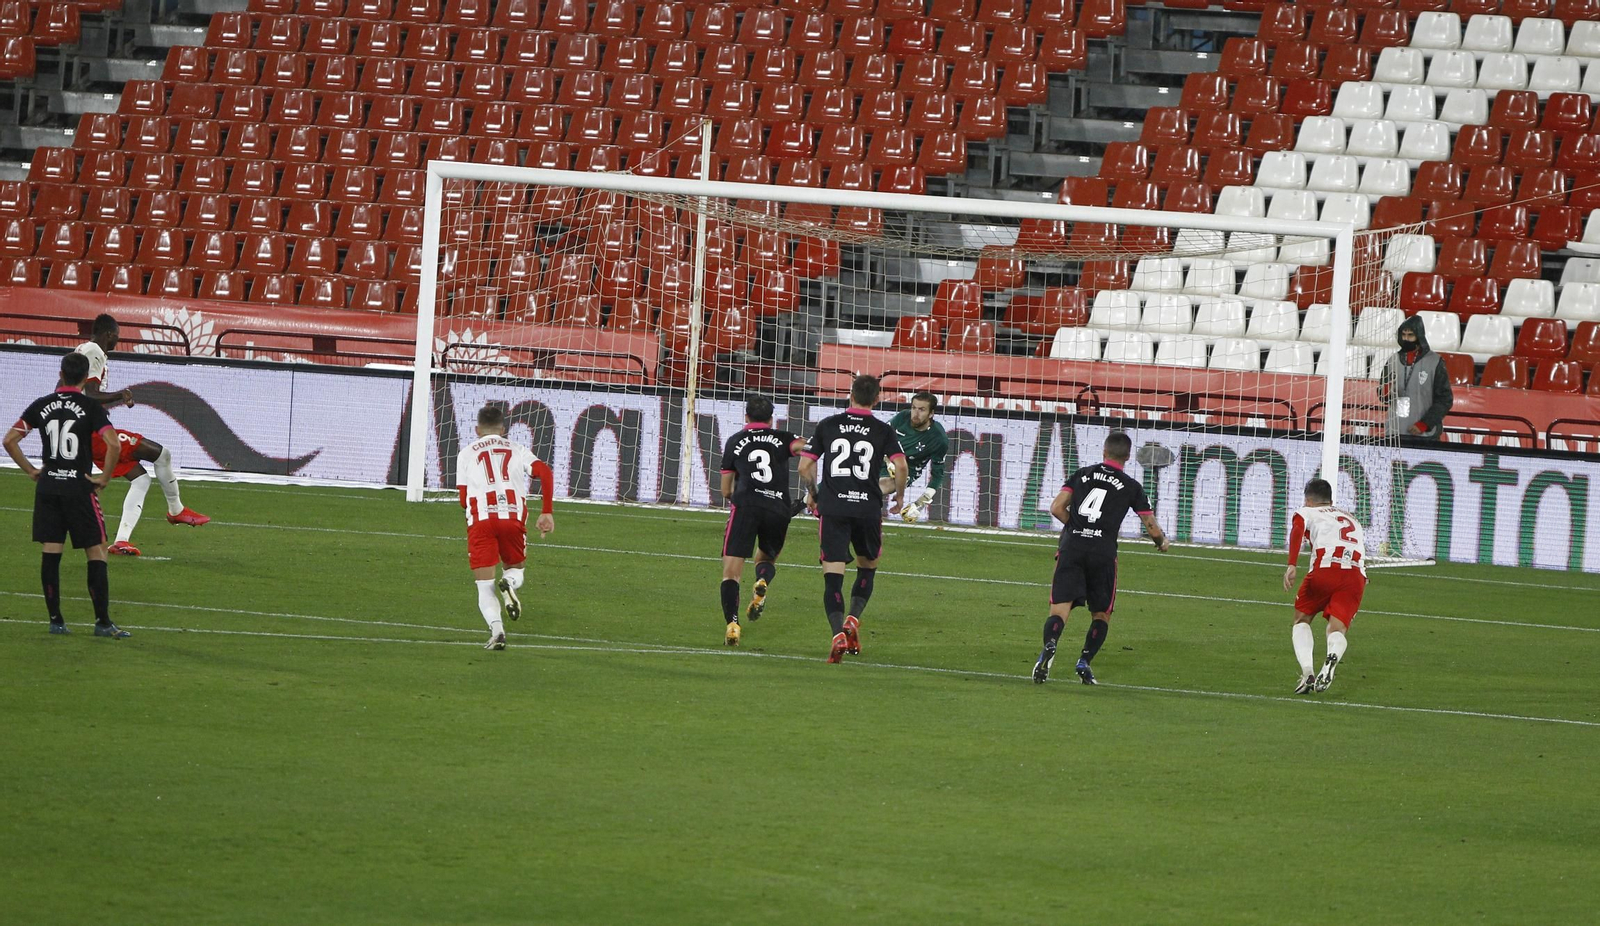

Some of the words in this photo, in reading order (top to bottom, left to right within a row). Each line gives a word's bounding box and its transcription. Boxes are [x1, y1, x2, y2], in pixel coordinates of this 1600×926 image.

[40, 401, 63, 419] AITOR
[64, 401, 86, 419] SANZ
[45, 419, 79, 460] 16
[472, 438, 511, 452] CORPAS
[733, 436, 751, 456] ALEX
[753, 434, 784, 448] MUÑOZ
[476, 448, 512, 485] 17
[747, 449, 773, 484] 3
[830, 438, 874, 481] 23
[1093, 472, 1125, 491] WILSON
[1077, 487, 1108, 523] 4
[1335, 515, 1358, 544] 2
